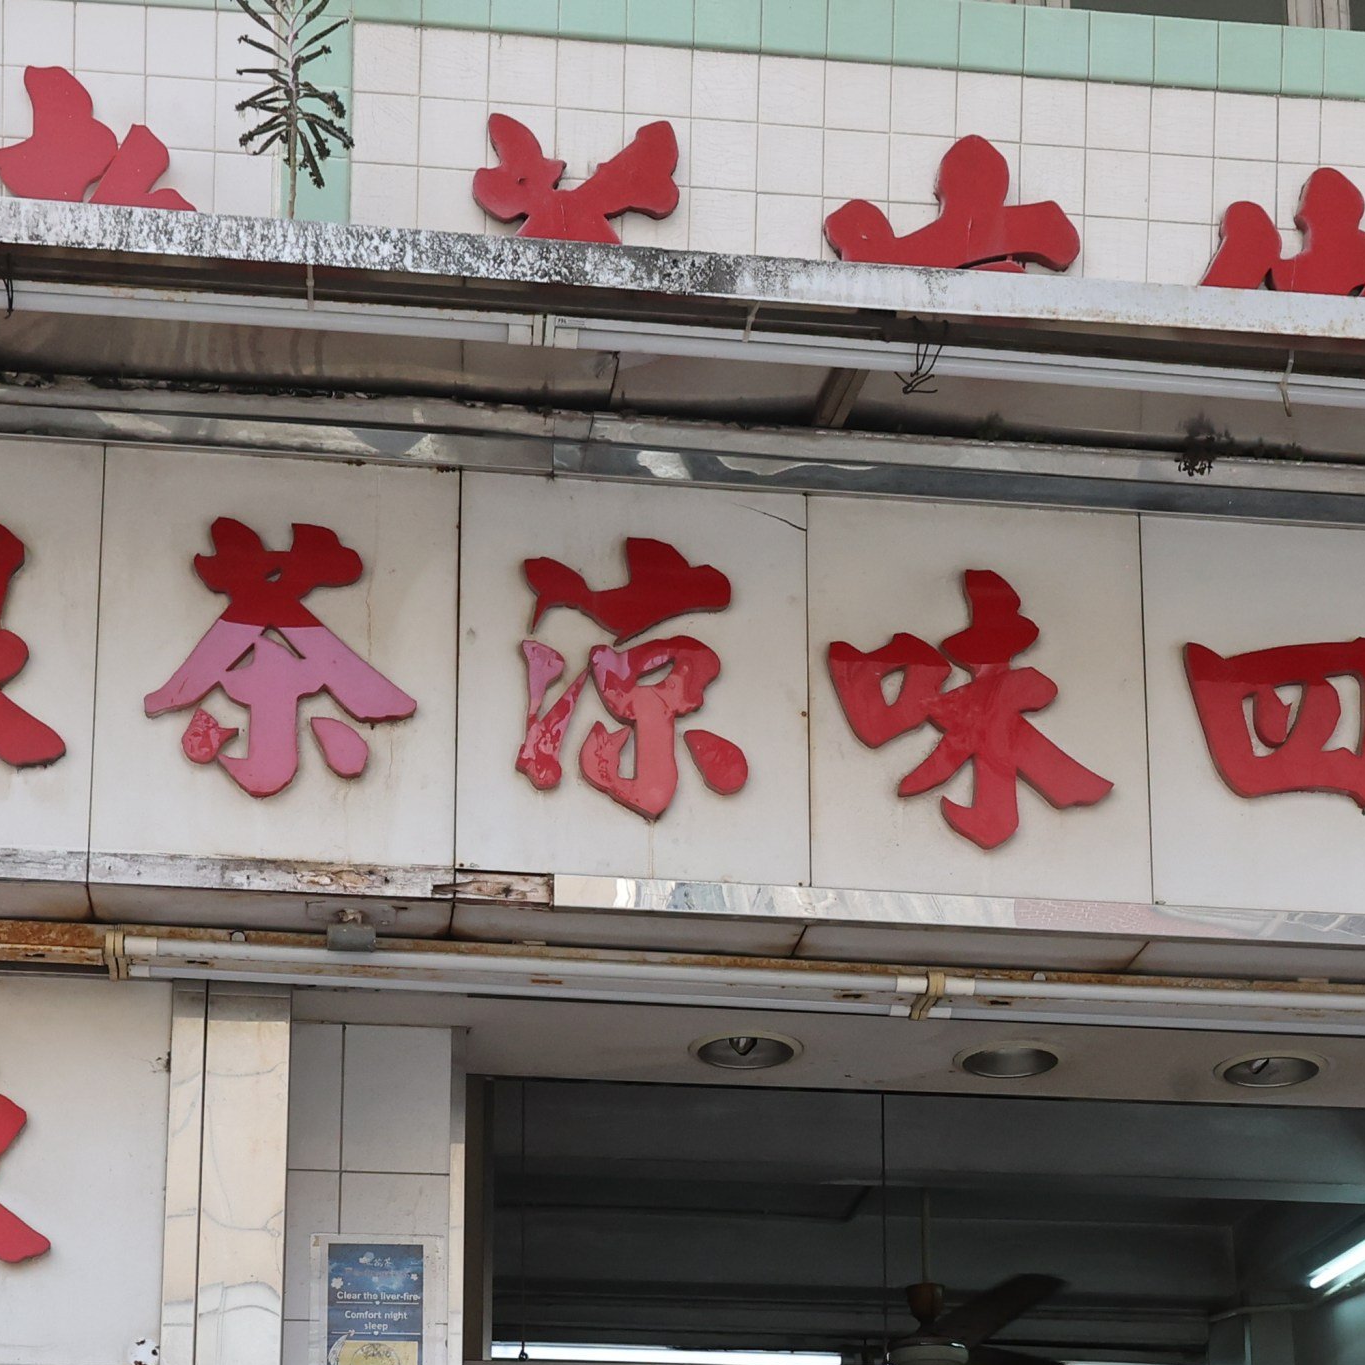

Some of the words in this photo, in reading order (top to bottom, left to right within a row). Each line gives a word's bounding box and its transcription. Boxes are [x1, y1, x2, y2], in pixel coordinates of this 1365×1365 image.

[336, 1291, 361, 1300] Clear
[363, 1291, 378, 1300] the
[344, 1310, 382, 1319] Comfort
[384, 1311, 408, 1321] night
[364, 1322, 388, 1331] sleep
